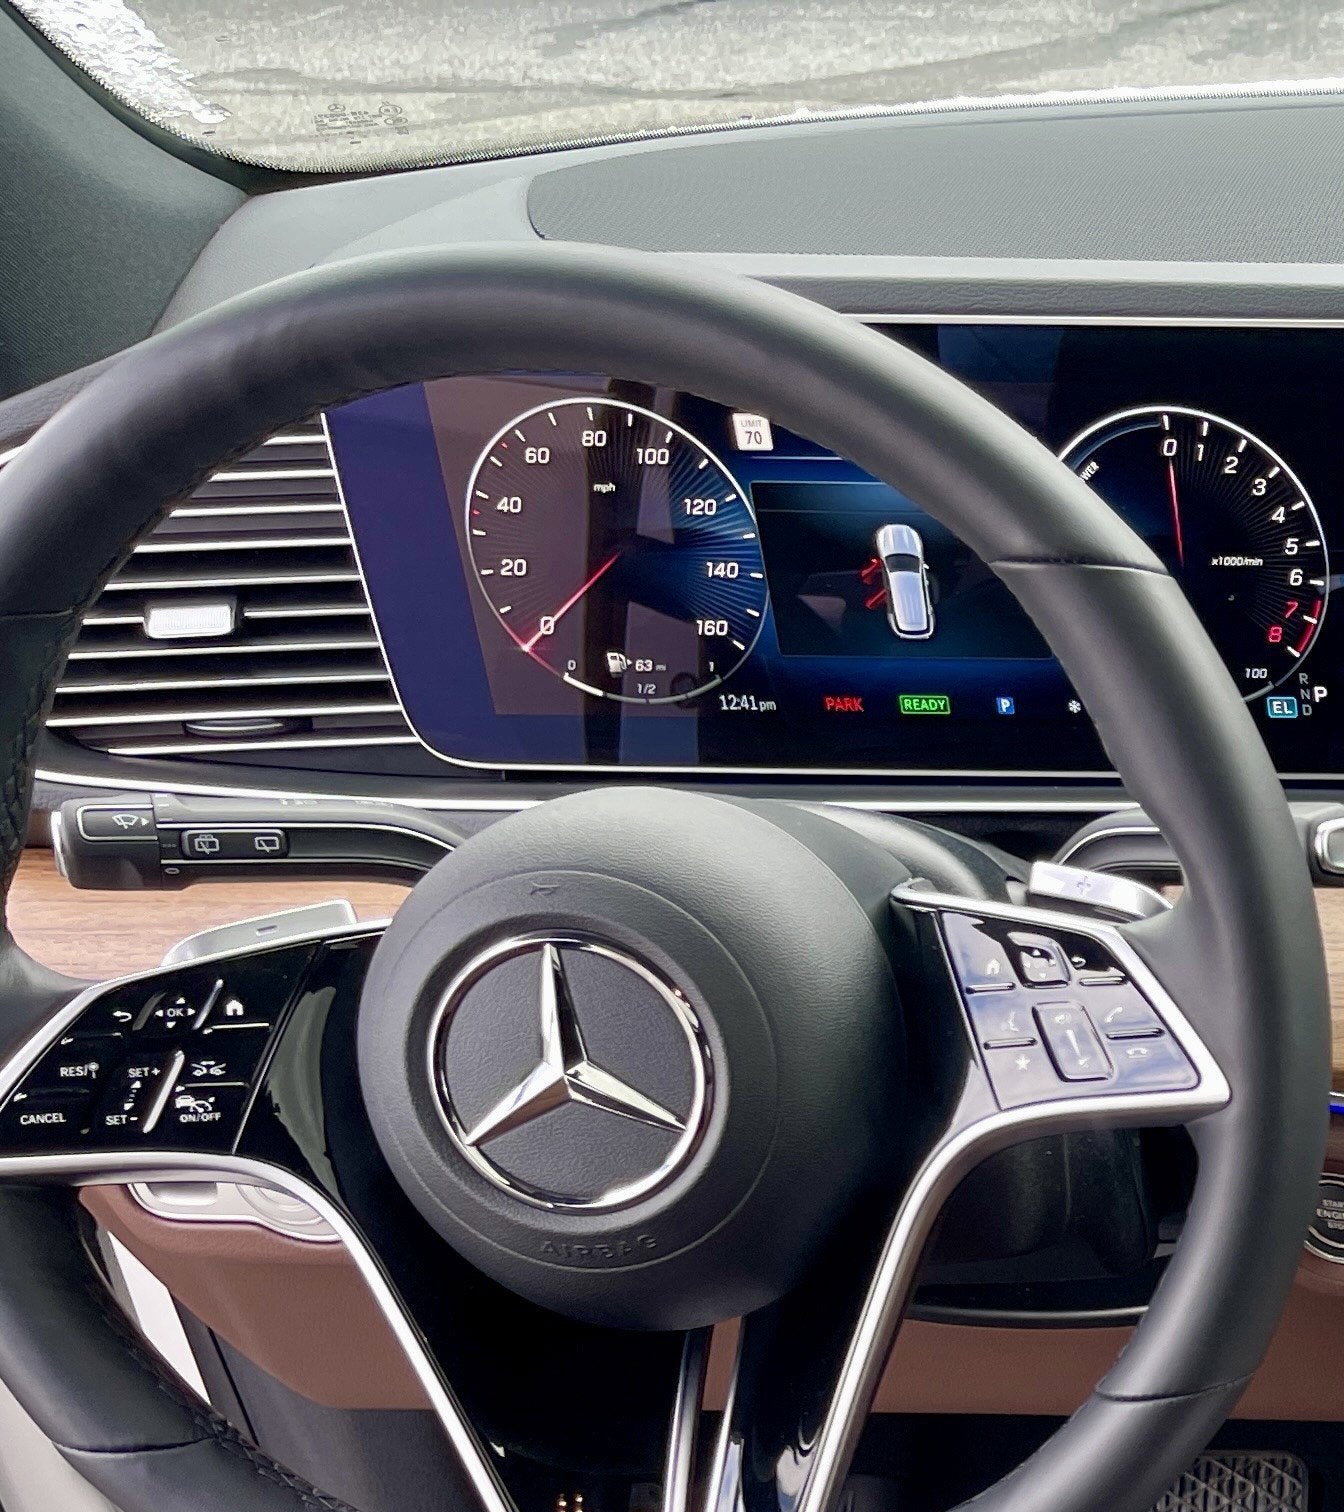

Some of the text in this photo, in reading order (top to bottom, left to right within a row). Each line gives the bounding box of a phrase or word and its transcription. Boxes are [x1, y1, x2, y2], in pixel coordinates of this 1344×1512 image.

[582, 431, 607, 447] 80
[745, 430, 763, 445] 70
[525, 447, 550, 464] 60
[1162, 438, 1177, 457] 0
[1197, 443, 1205, 461] 1
[636, 448, 670, 465] 100
[1224, 456, 1239, 474] 2
[594, 484, 616, 494] mph
[1252, 478, 1267, 496] 3
[497, 497, 522, 514] 40
[684, 499, 717, 515] 120
[1271, 506, 1286, 524] 4
[1284, 538, 1299, 555] 5
[501, 559, 527, 576] 20
[706, 562, 739, 578] 140
[1289, 569, 1303, 586] 6
[1284, 600, 1299, 618] 7
[539, 617, 555, 634] 0
[696, 620, 728, 636] 160
[1267, 626, 1282, 643] 8
[567, 659, 577, 671] 0
[635, 659, 653, 672] 63
[708, 661, 715, 673] 1
[1245, 667, 1268, 679] 100
[1298, 672, 1309, 684] R
[636, 683, 657, 695] 1/2
[1300, 688, 1311, 700] N
[1313, 686, 1328, 702] P
[825, 697, 864, 711] PARK
[903, 698, 947, 712] READY
[1272, 700, 1294, 714] EL
[1302, 703, 1312, 716] D
[166, 1008, 185, 1018] OK
[20, 1112, 67, 1126] CANCEL
[179, 1111, 222, 1123] ON/OFF
